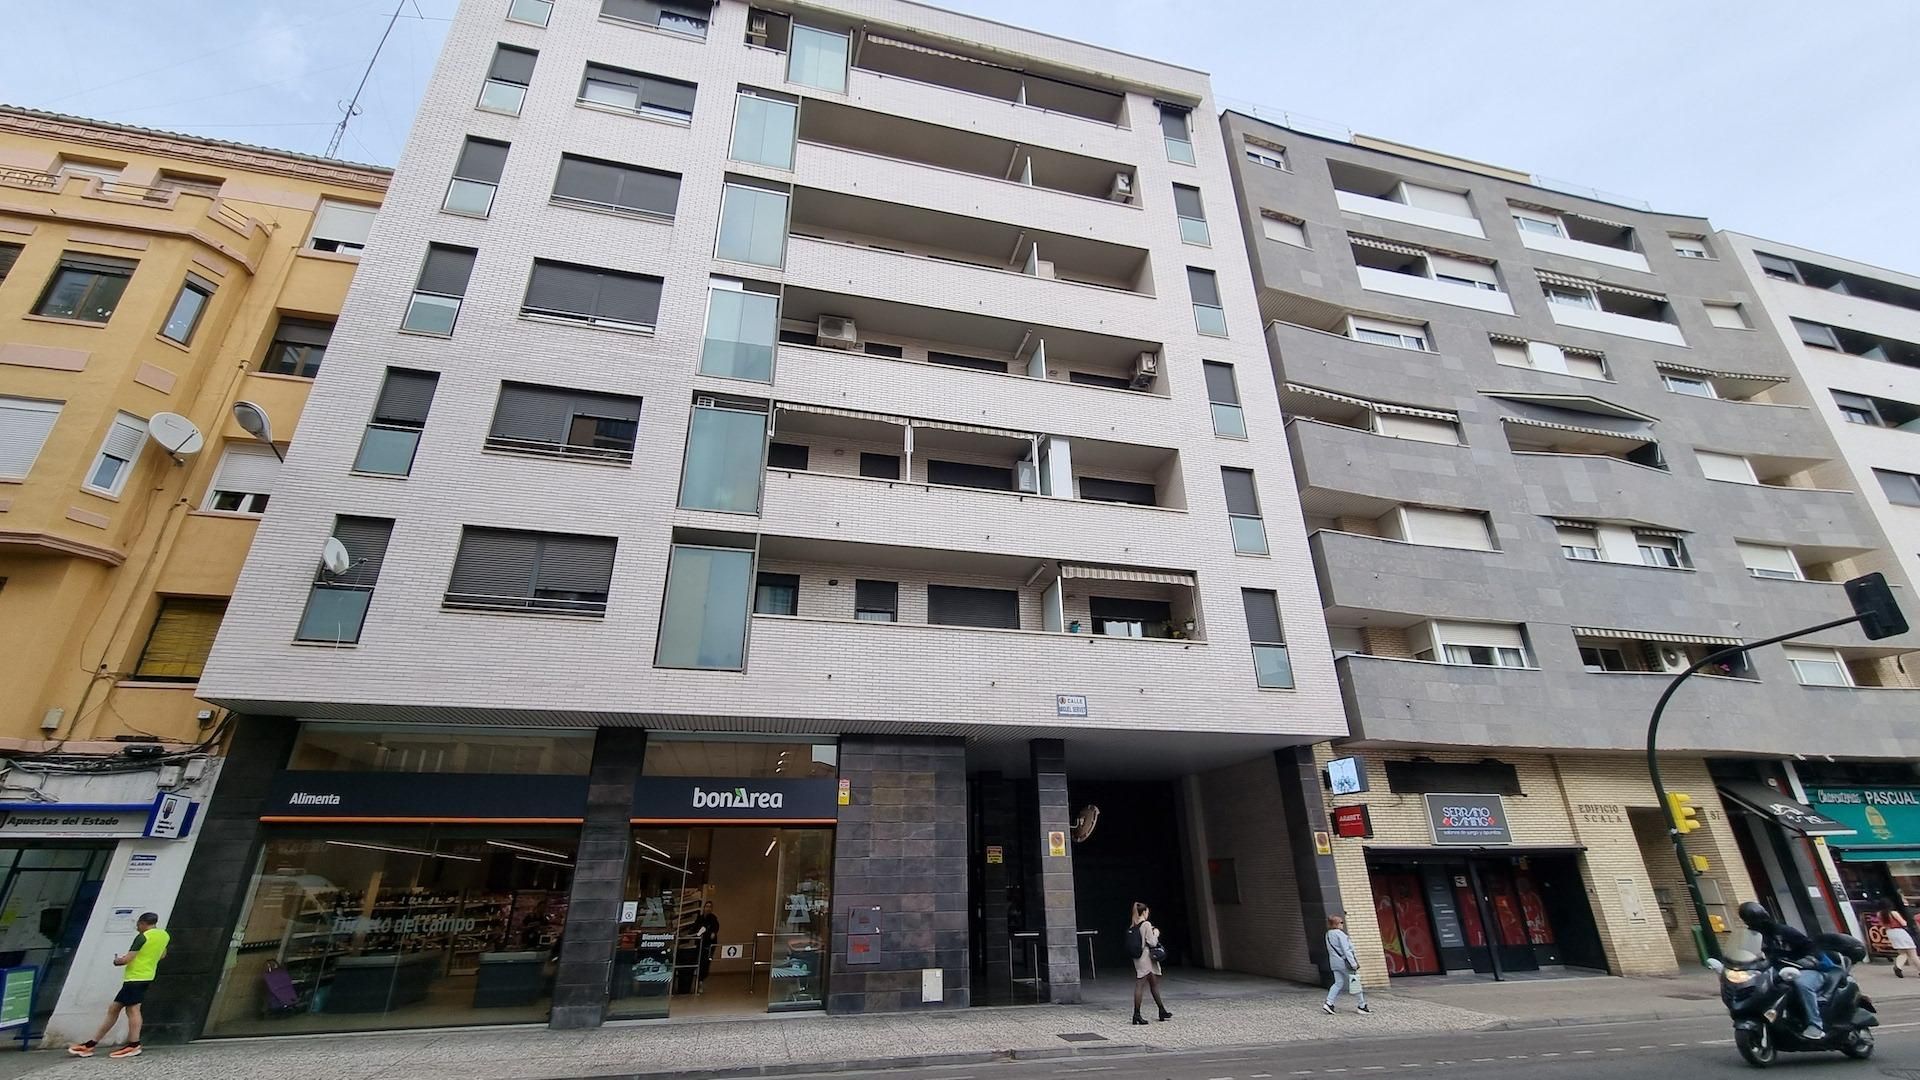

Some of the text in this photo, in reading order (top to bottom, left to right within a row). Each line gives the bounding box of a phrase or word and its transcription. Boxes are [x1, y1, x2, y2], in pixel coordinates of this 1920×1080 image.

[289, 792, 341, 805] Alimenta
[1864, 791, 1919, 805] PASCUAL
[1442, 807, 1490, 818] SERRANO
[1578, 804, 1619, 814] EDIFICIO
[7, 816, 119, 826] Apuestas del Estado
[1450, 817, 1489, 827] GAMING
[1584, 814, 1622, 823] SCALA
[420, 917, 476, 937] campo
[641, 933, 675, 941] Bienvenidos
